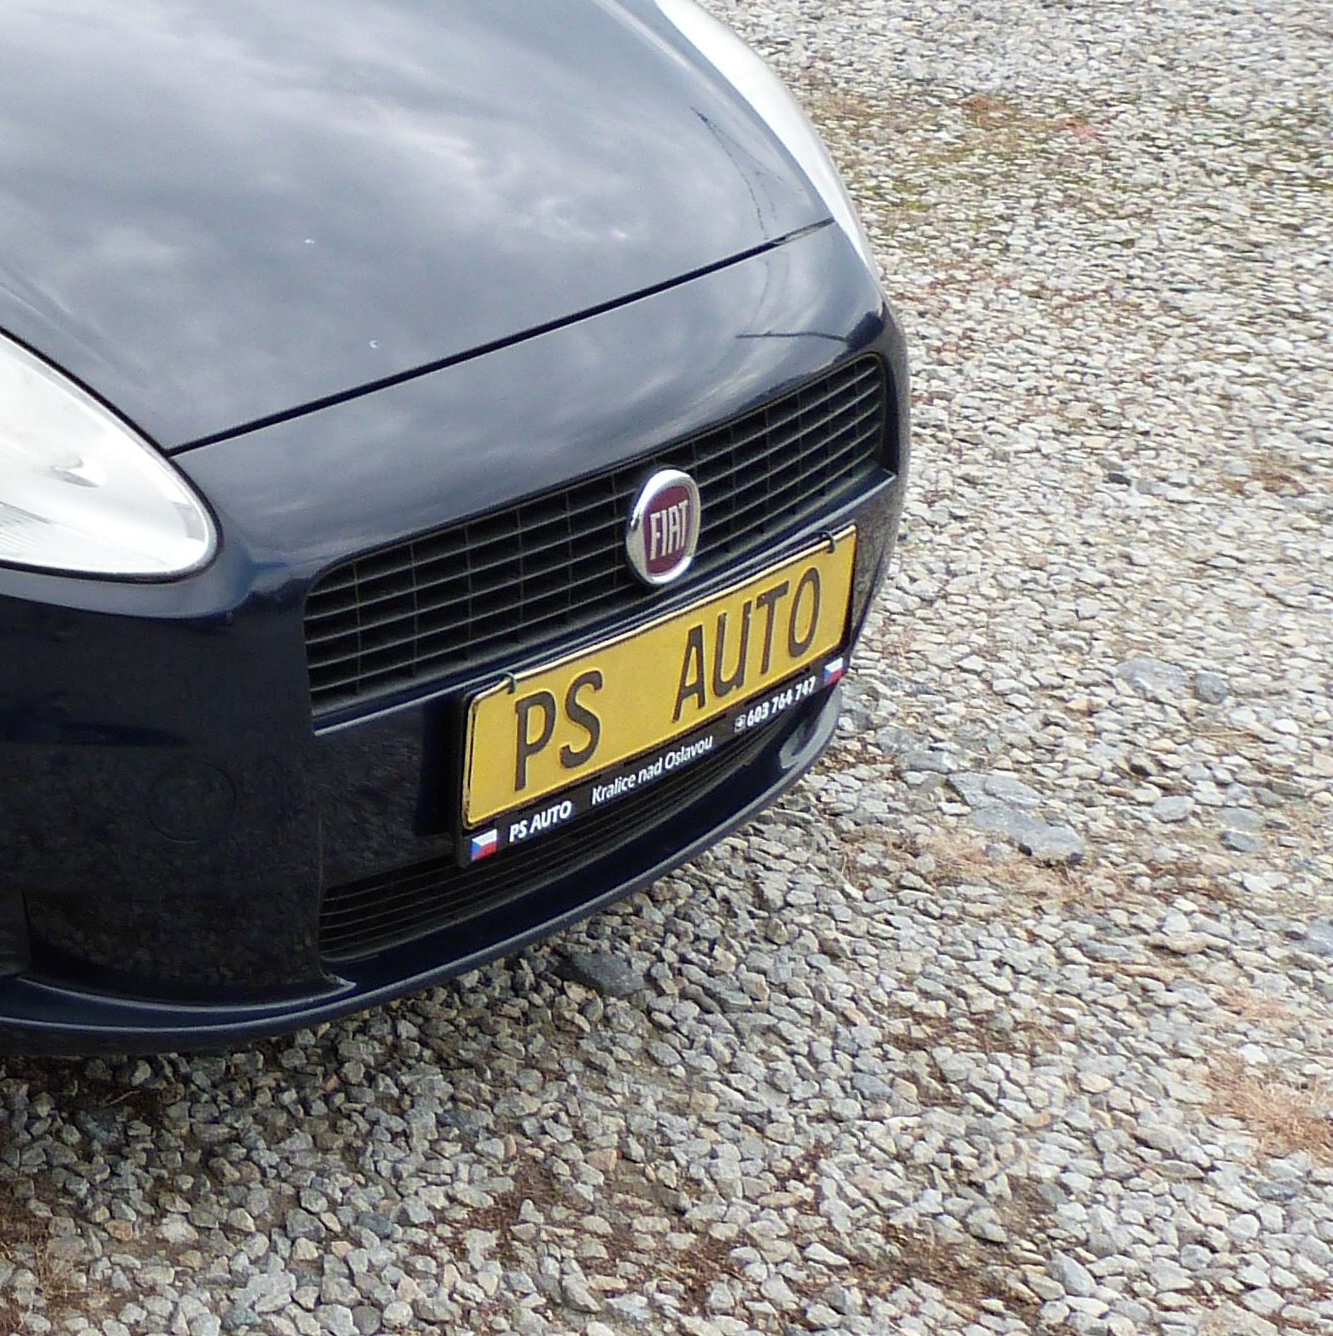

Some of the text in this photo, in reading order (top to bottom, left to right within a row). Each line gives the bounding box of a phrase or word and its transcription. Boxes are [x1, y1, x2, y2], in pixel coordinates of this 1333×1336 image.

[650, 499, 689, 561] FIAT
[509, 675, 816, 843] PS AUTO Kralice nad Oslavou 603 764 747
[514, 566, 821, 792] PS AUTO
